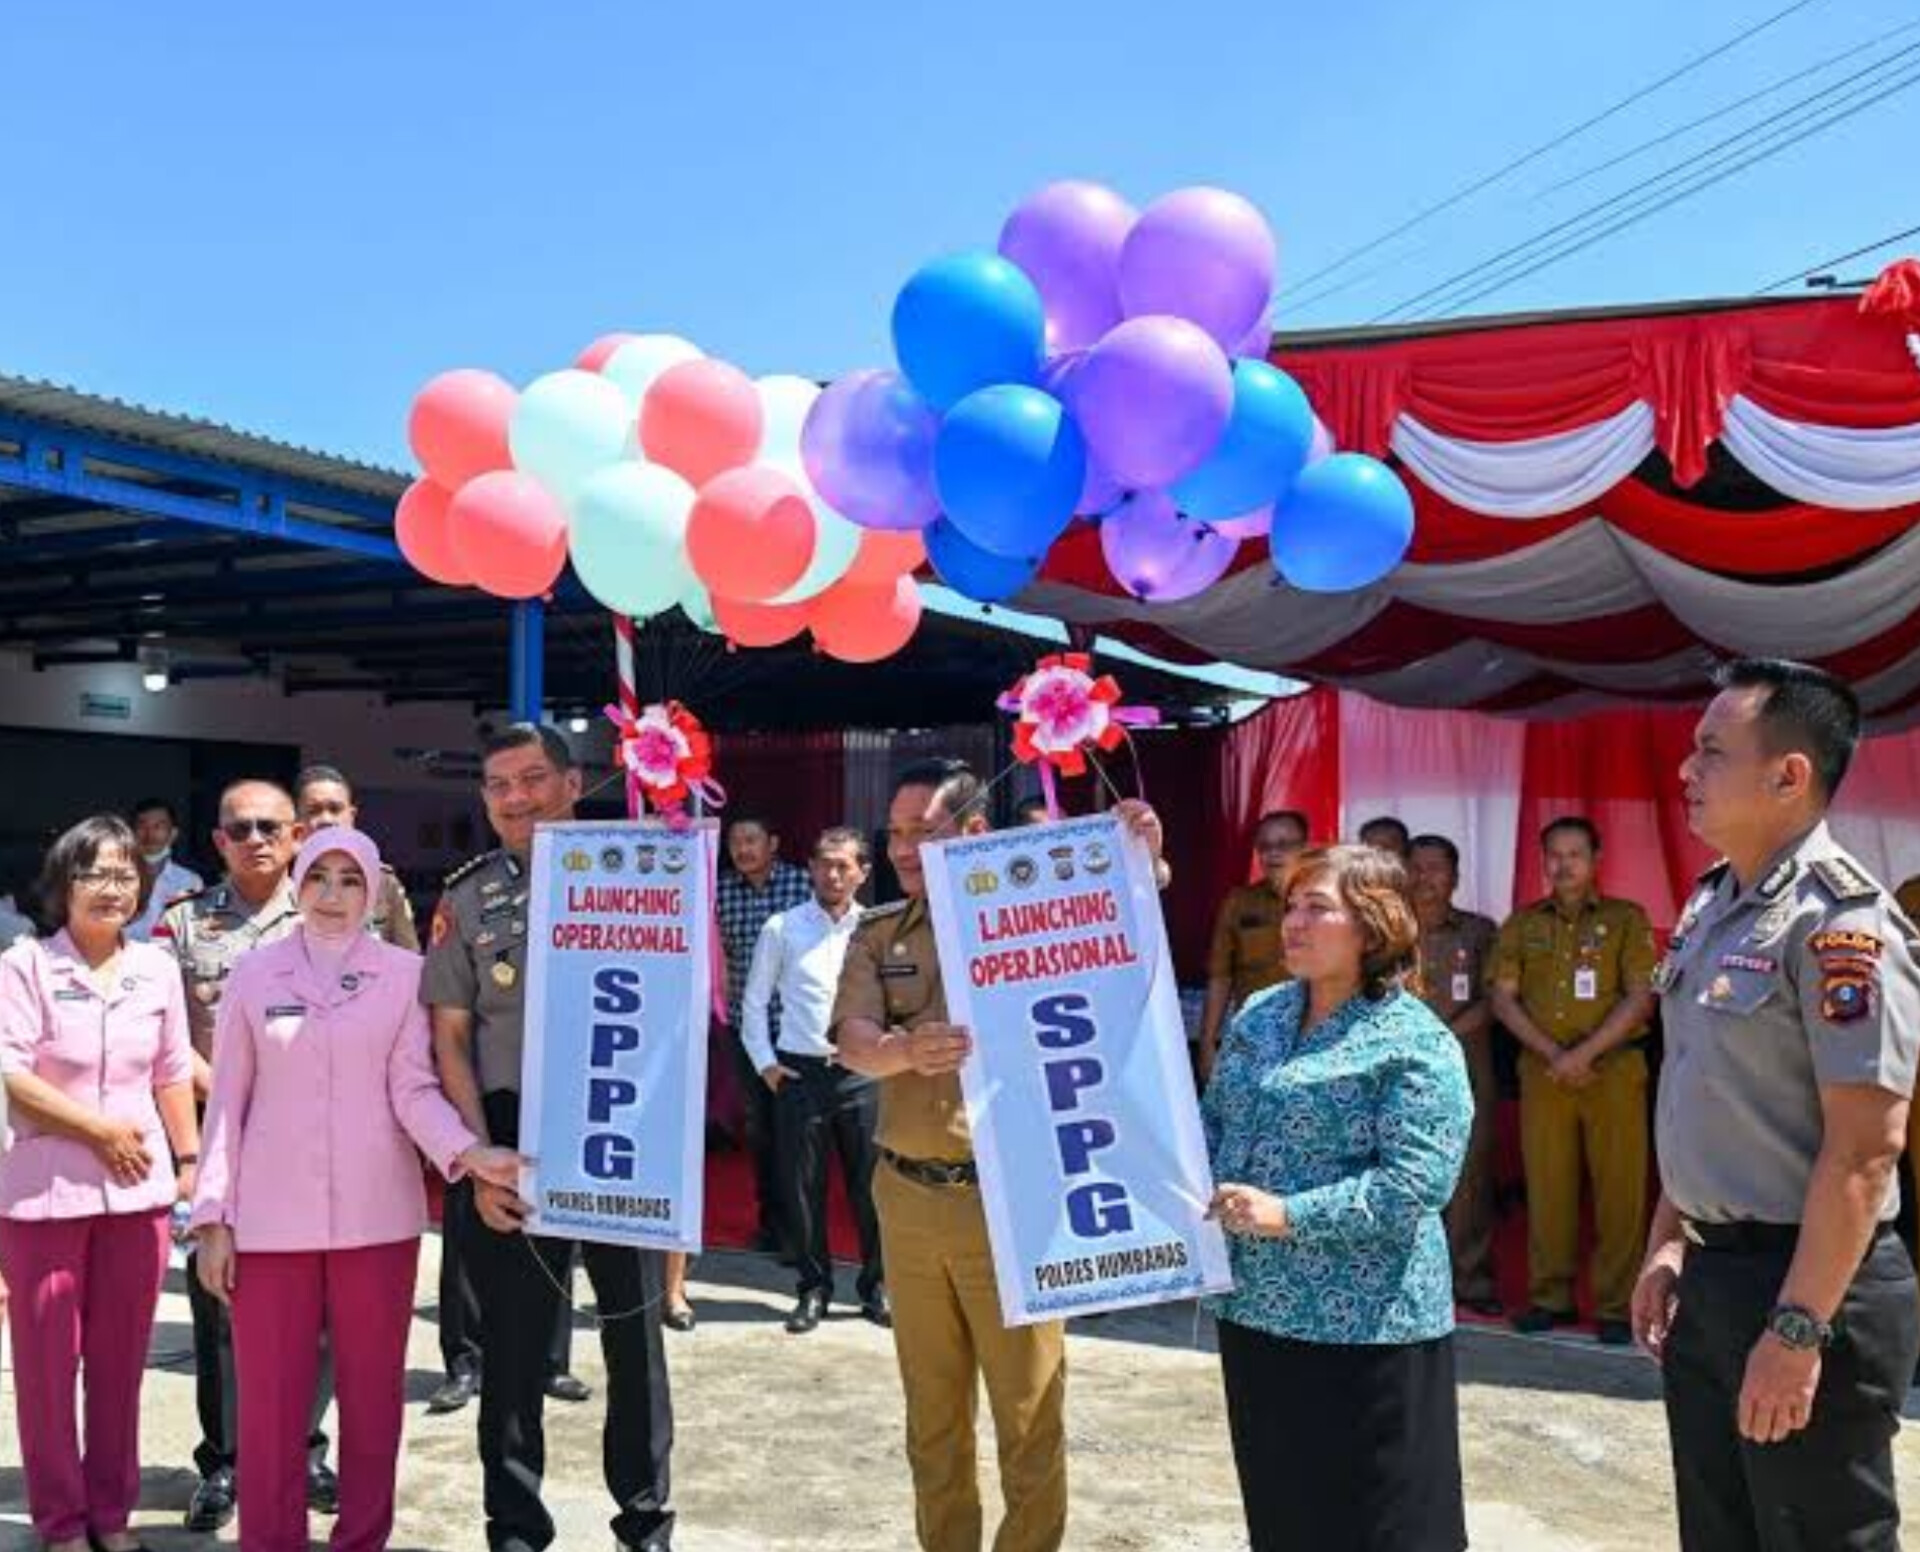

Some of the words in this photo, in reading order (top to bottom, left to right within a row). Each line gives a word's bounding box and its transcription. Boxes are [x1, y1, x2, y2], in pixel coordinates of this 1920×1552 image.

[568, 885, 681, 916] LAUNCHING
[978, 890, 1118, 942] LAUNCHING
[552, 923, 690, 953] OPERASIONAL
[969, 933, 1138, 988] OPERASIONAL
[1035, 1257, 1095, 1291] POLRES
